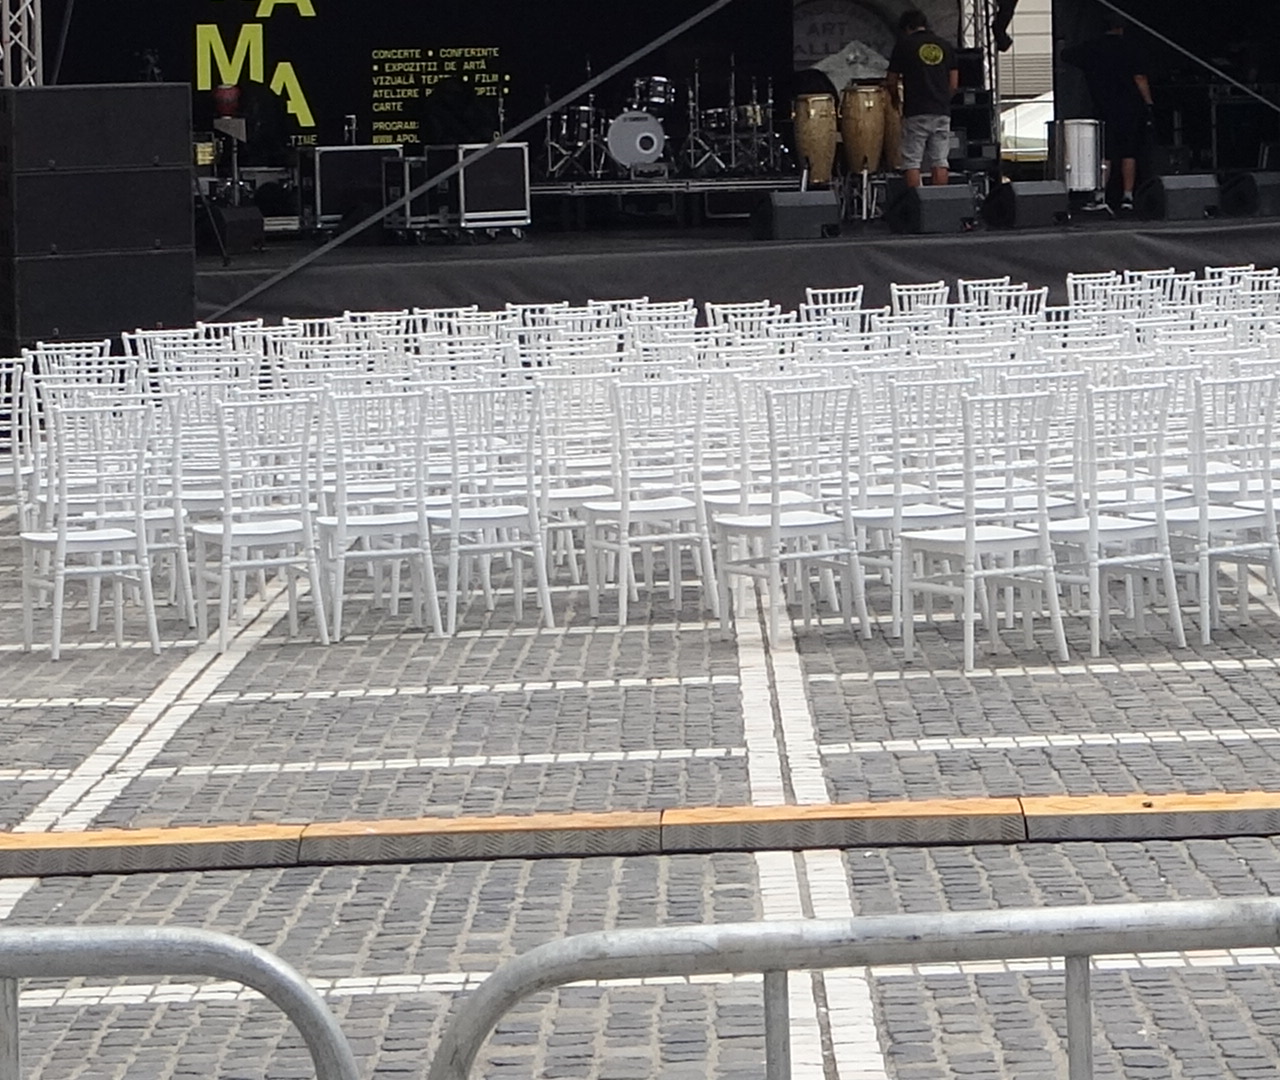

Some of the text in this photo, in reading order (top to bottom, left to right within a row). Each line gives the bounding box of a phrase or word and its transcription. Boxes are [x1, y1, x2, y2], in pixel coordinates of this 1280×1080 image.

[807, 22, 848, 36] ART
[372, 49, 421, 59] CONCERTE
[444, 61, 457, 71] DE
[463, 59, 486, 70] ARTĂ
[474, 74, 499, 83] FILM
[372, 88, 419, 99] ATELIERE
[372, 101, 404, 112] CARTE
